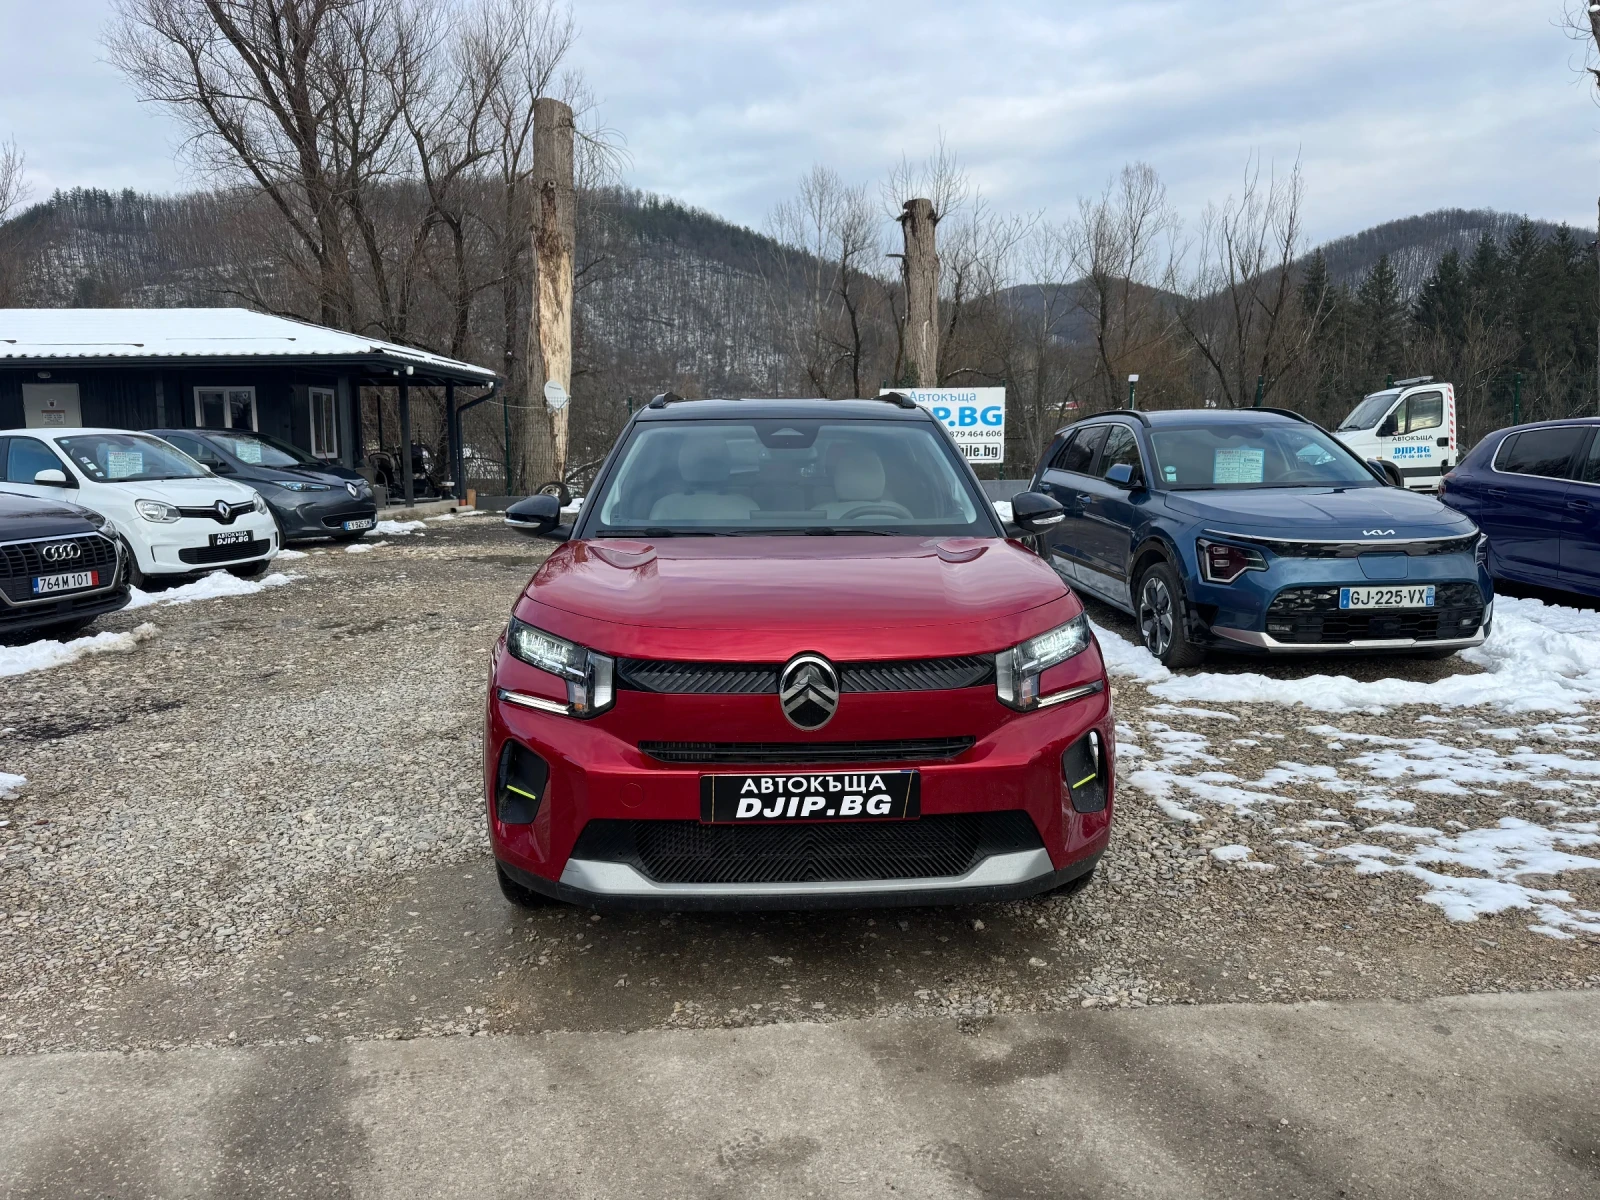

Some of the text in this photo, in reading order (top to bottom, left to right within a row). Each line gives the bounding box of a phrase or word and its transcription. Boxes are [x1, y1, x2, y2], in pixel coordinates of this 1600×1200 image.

[908, 391, 977, 403] Автокъща
[932, 406, 1003, 427] P.BG
[967, 430, 984, 438] 464
[985, 430, 1002, 438] 606
[1391, 434, 1434, 442] АВТОКЪЩА
[1394, 445, 1430, 454] DJIP.BG
[216, 535, 249, 546] DJIP.BG
[71, 573, 89, 587] 101
[1350, 588, 1425, 605] GJ-225-VX
[740, 775, 887, 794] АВТОКЪЩА
[735, 794, 892, 818] DJIP.BG
